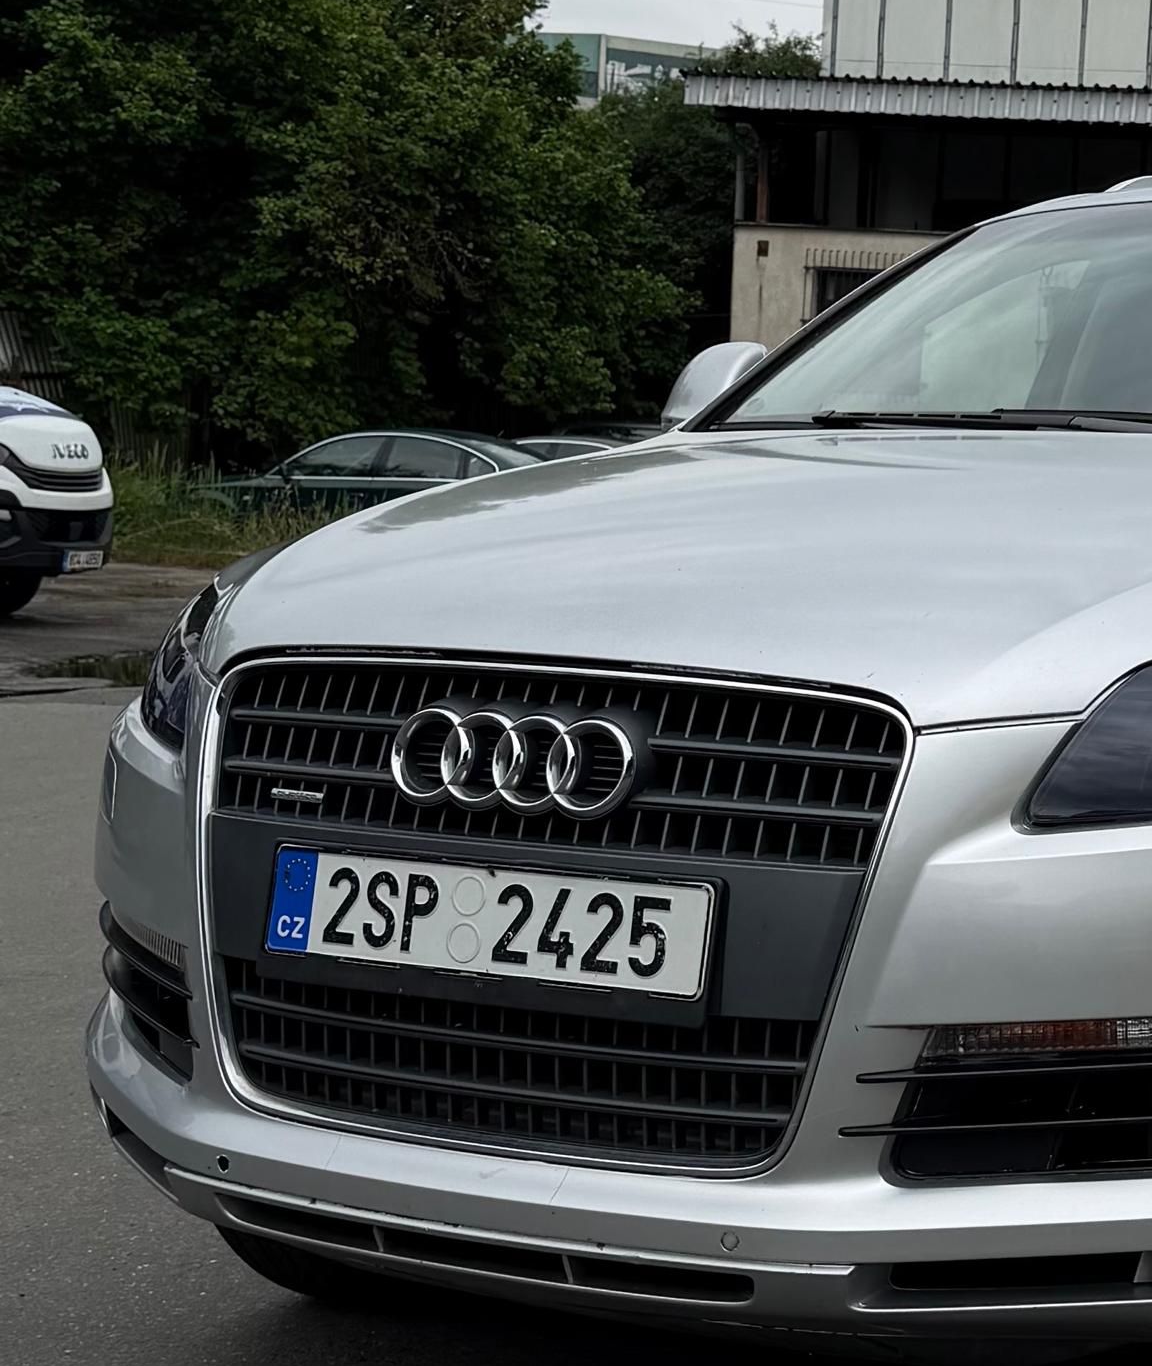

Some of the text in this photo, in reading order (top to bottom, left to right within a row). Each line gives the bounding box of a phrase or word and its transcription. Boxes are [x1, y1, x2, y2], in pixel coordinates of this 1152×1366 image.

[51, 444, 89, 459] IVECO
[277, 915, 305, 938] CZ
[323, 867, 672, 977] 2SP 2425
